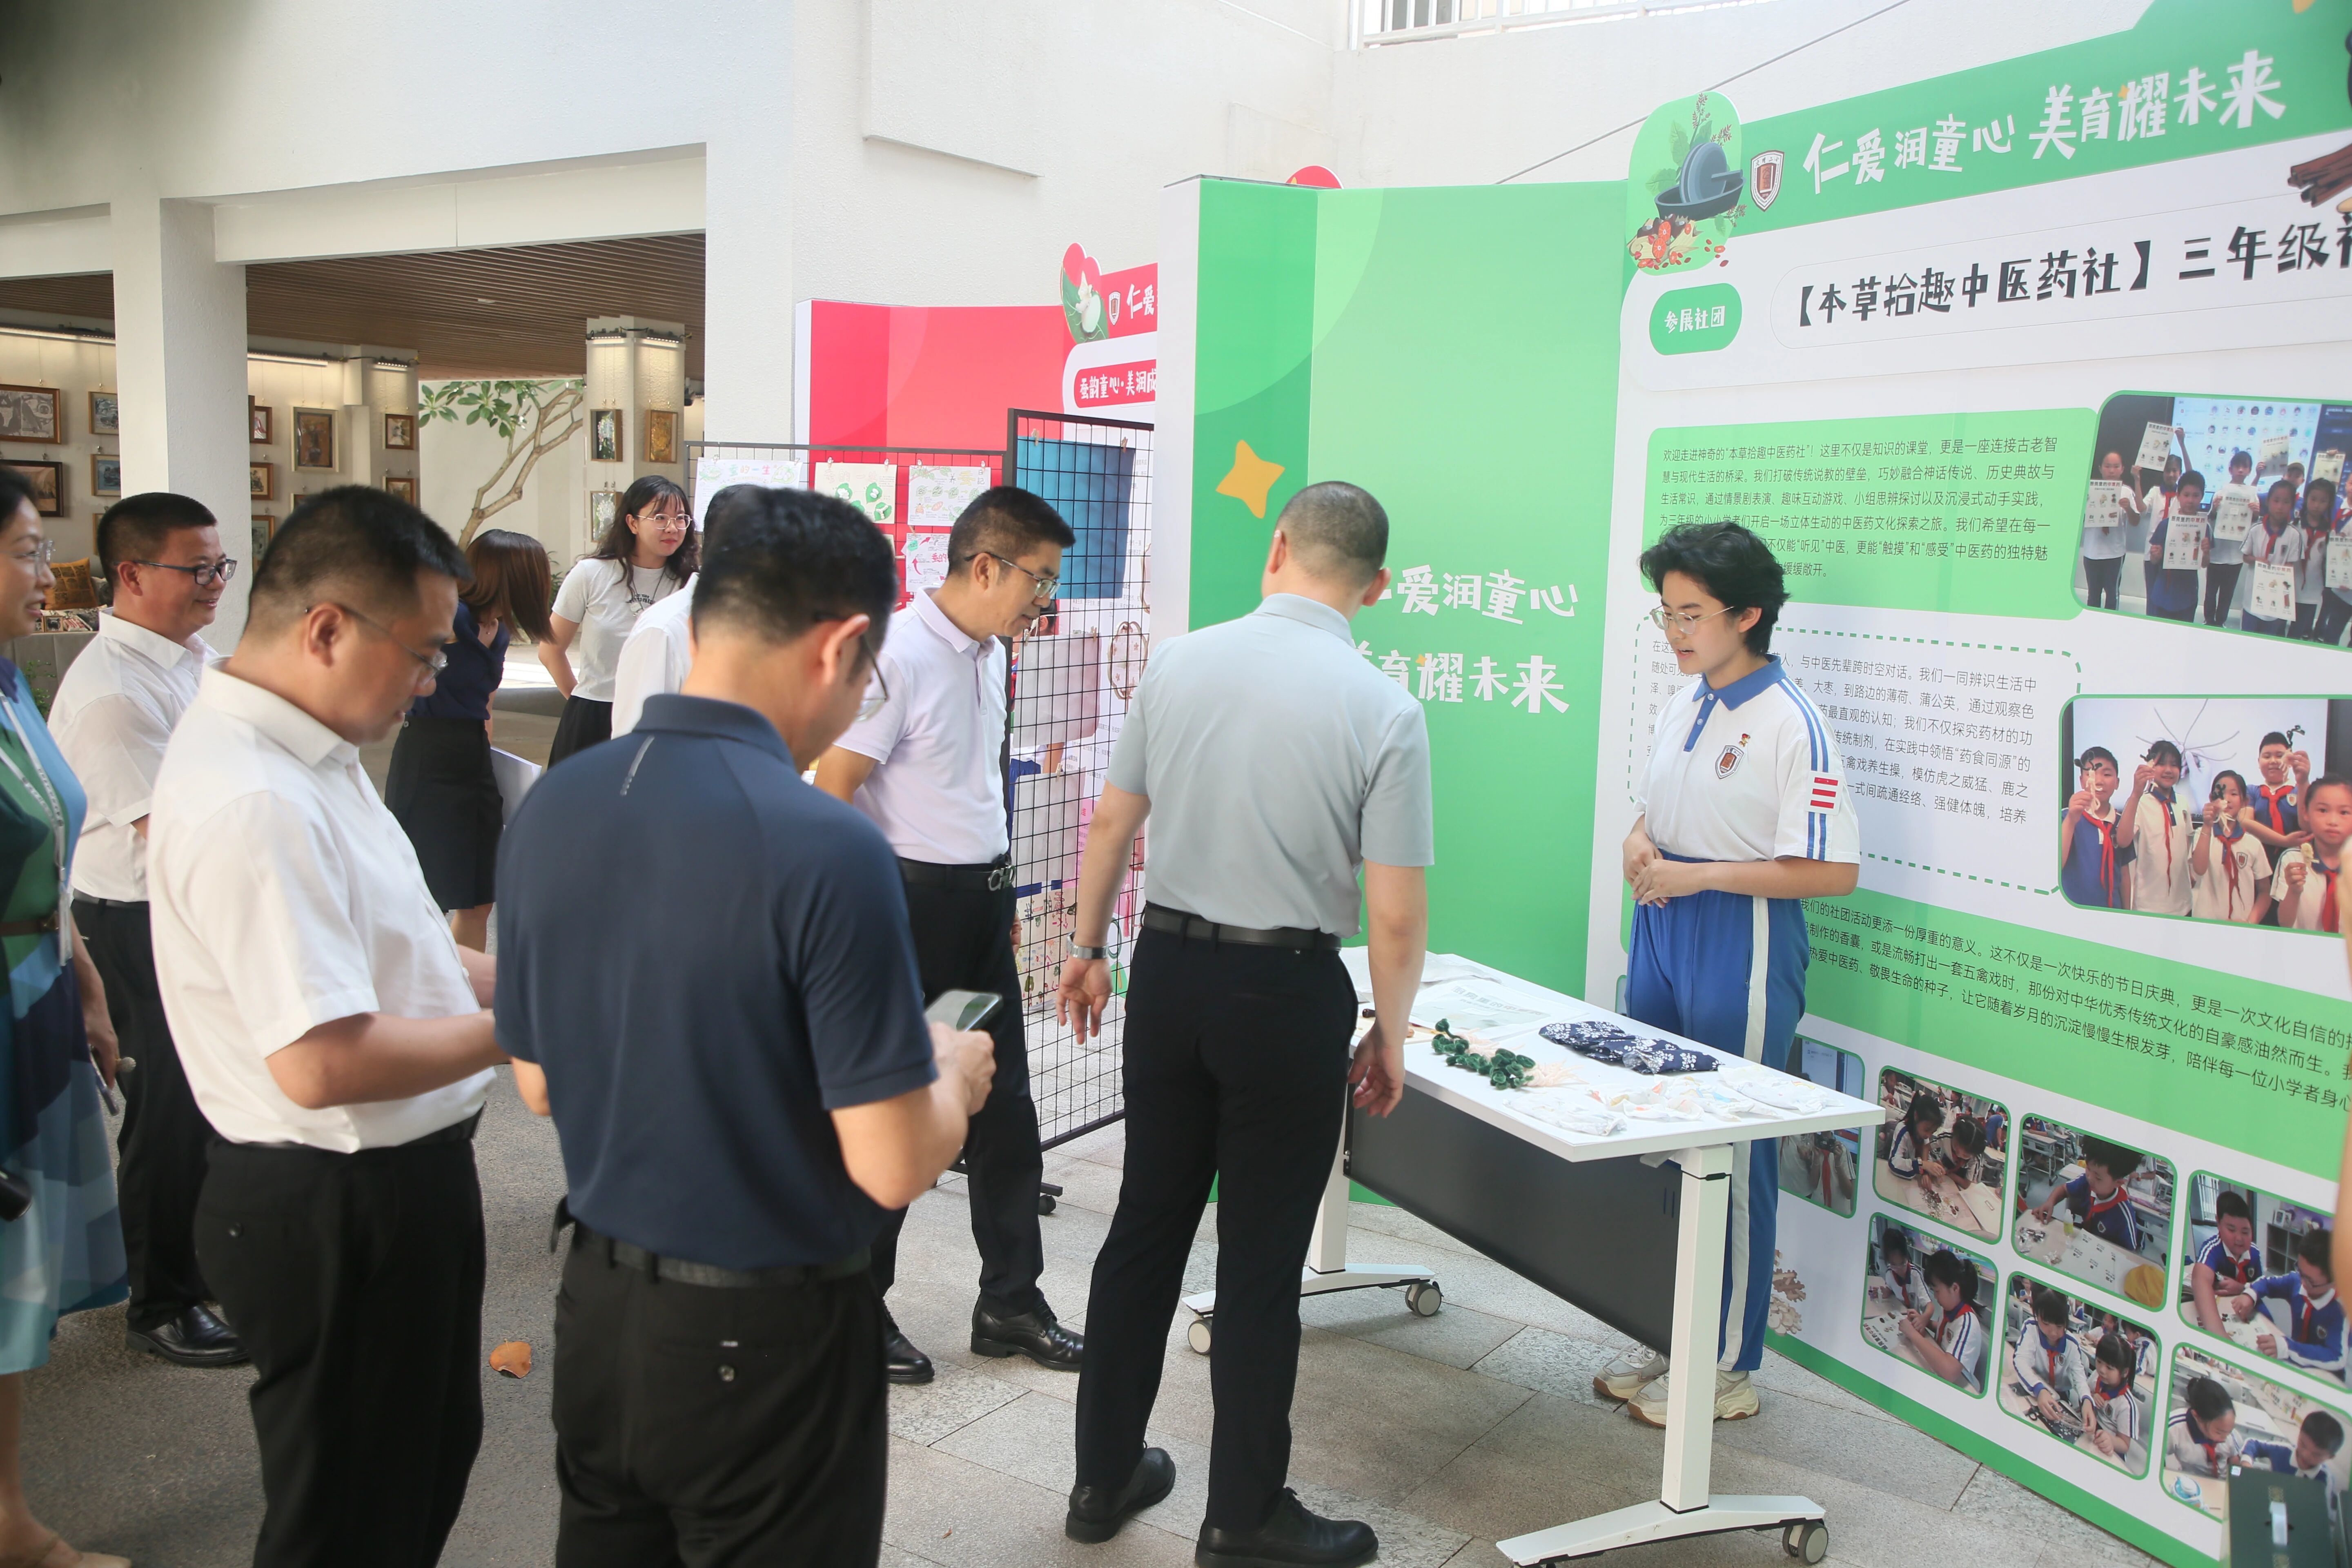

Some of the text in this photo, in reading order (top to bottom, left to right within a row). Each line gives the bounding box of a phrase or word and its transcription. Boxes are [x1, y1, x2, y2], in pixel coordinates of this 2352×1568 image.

[1803, 50, 2286, 194] 仁爱润童心 美育耀未来
[1126, 283, 1158, 320] 仁爱
[1663, 305, 1726, 333] 参展社团
[1762, 537, 2049, 561] 不仅能“听见”中医，更能“触摸”和“感受”中医药的独特魅
[1778, 561, 1826, 577] 缓缓敞开。
[1378, 564, 1579, 625] 爱润童心
[1771, 651, 2036, 693] 人，与中医先辈跨时空对话。我们一同辨识生活中
